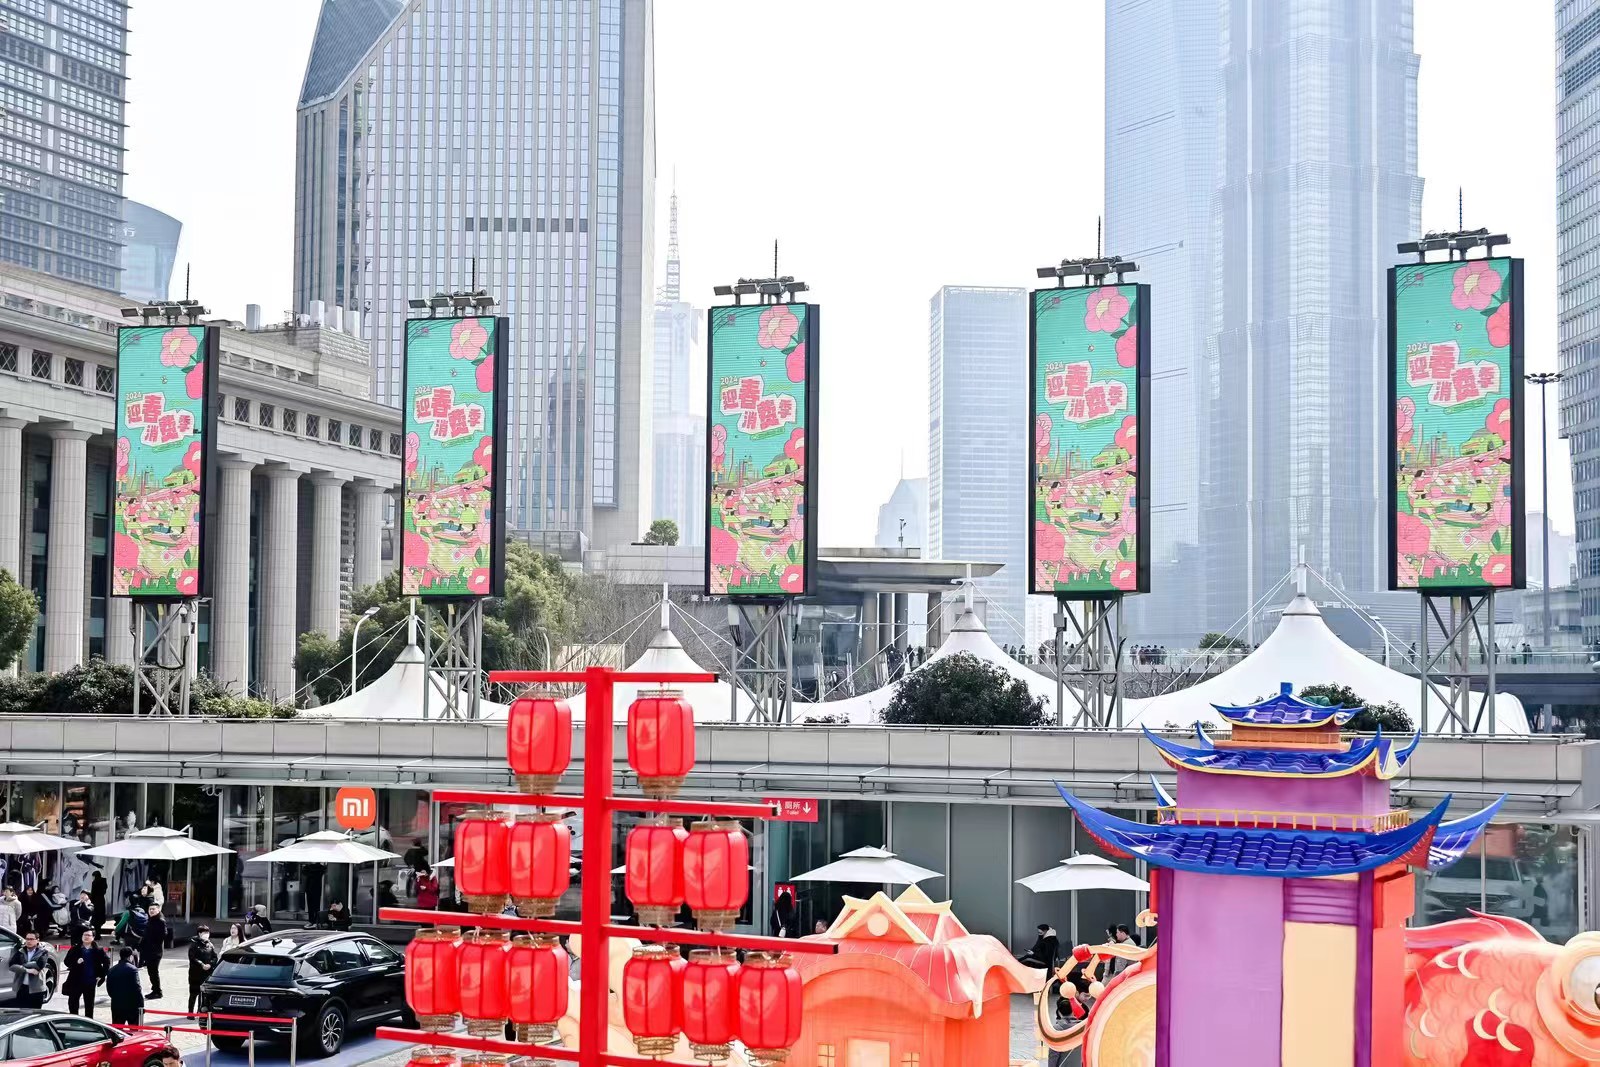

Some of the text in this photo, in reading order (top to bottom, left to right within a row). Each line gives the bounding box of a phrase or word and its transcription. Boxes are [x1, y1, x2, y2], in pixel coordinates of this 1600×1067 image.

[1406, 342, 1428, 353] 2024
[1045, 361, 1065, 370] 2024
[1409, 345, 1456, 381] 迎春
[414, 385, 432, 395] 2024
[721, 376, 739, 385] 2024
[722, 378, 760, 410] 迎春
[1047, 364, 1089, 398] 迎春
[1433, 367, 1495, 402] 消费季
[126, 392, 142, 401] 2024
[127, 394, 162, 424] 迎春
[416, 388, 452, 419] 迎春
[1067, 386, 1123, 418] 消费季
[144, 414, 192, 442] 消费季
[433, 408, 482, 438] 消费季
[741, 399, 793, 430] 消费季
